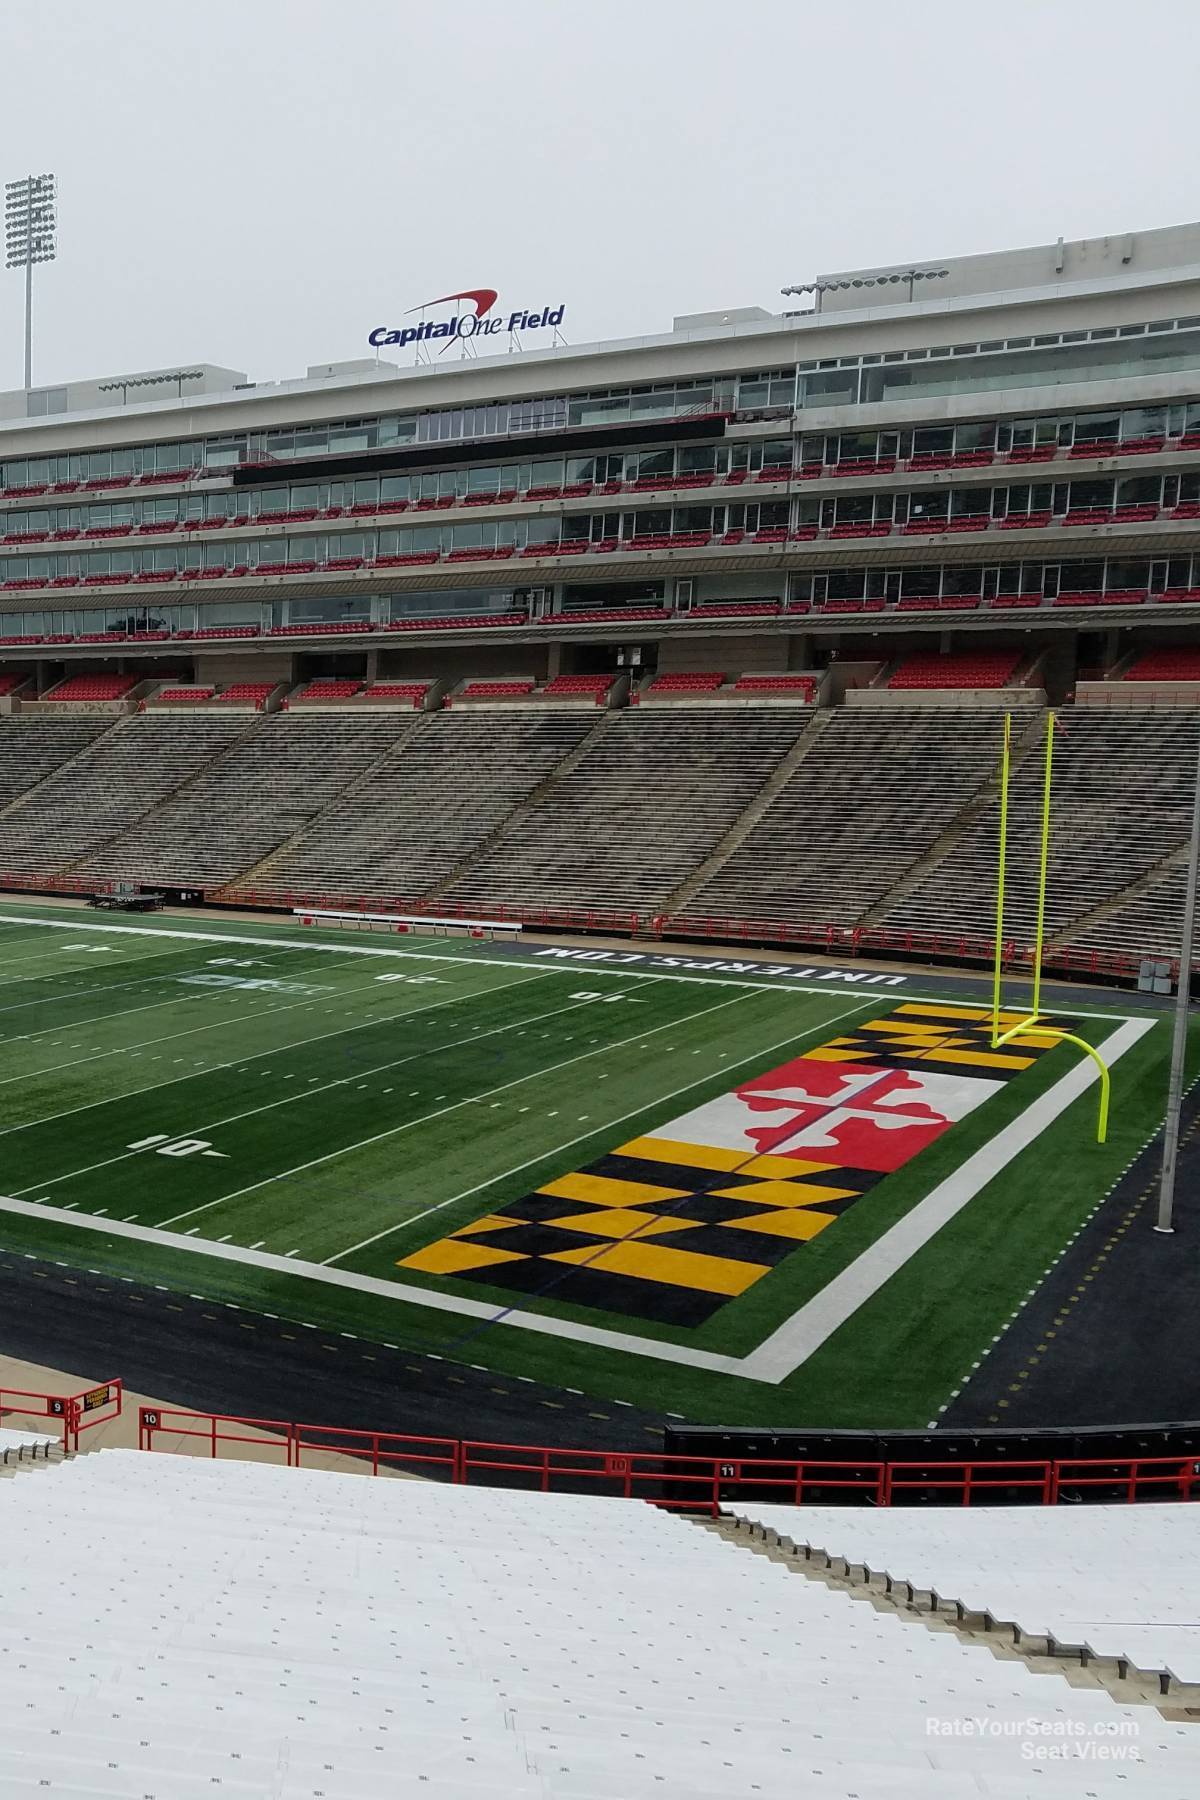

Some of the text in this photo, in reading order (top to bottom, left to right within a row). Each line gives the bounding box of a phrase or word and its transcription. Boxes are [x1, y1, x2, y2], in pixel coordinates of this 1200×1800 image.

[507, 303, 566, 332] Field
[125, 1134, 213, 1157] 10
[53, 1402, 61, 1412] 9
[144, 1413, 157, 1424] 10
[721, 1466, 734, 1476] 11
